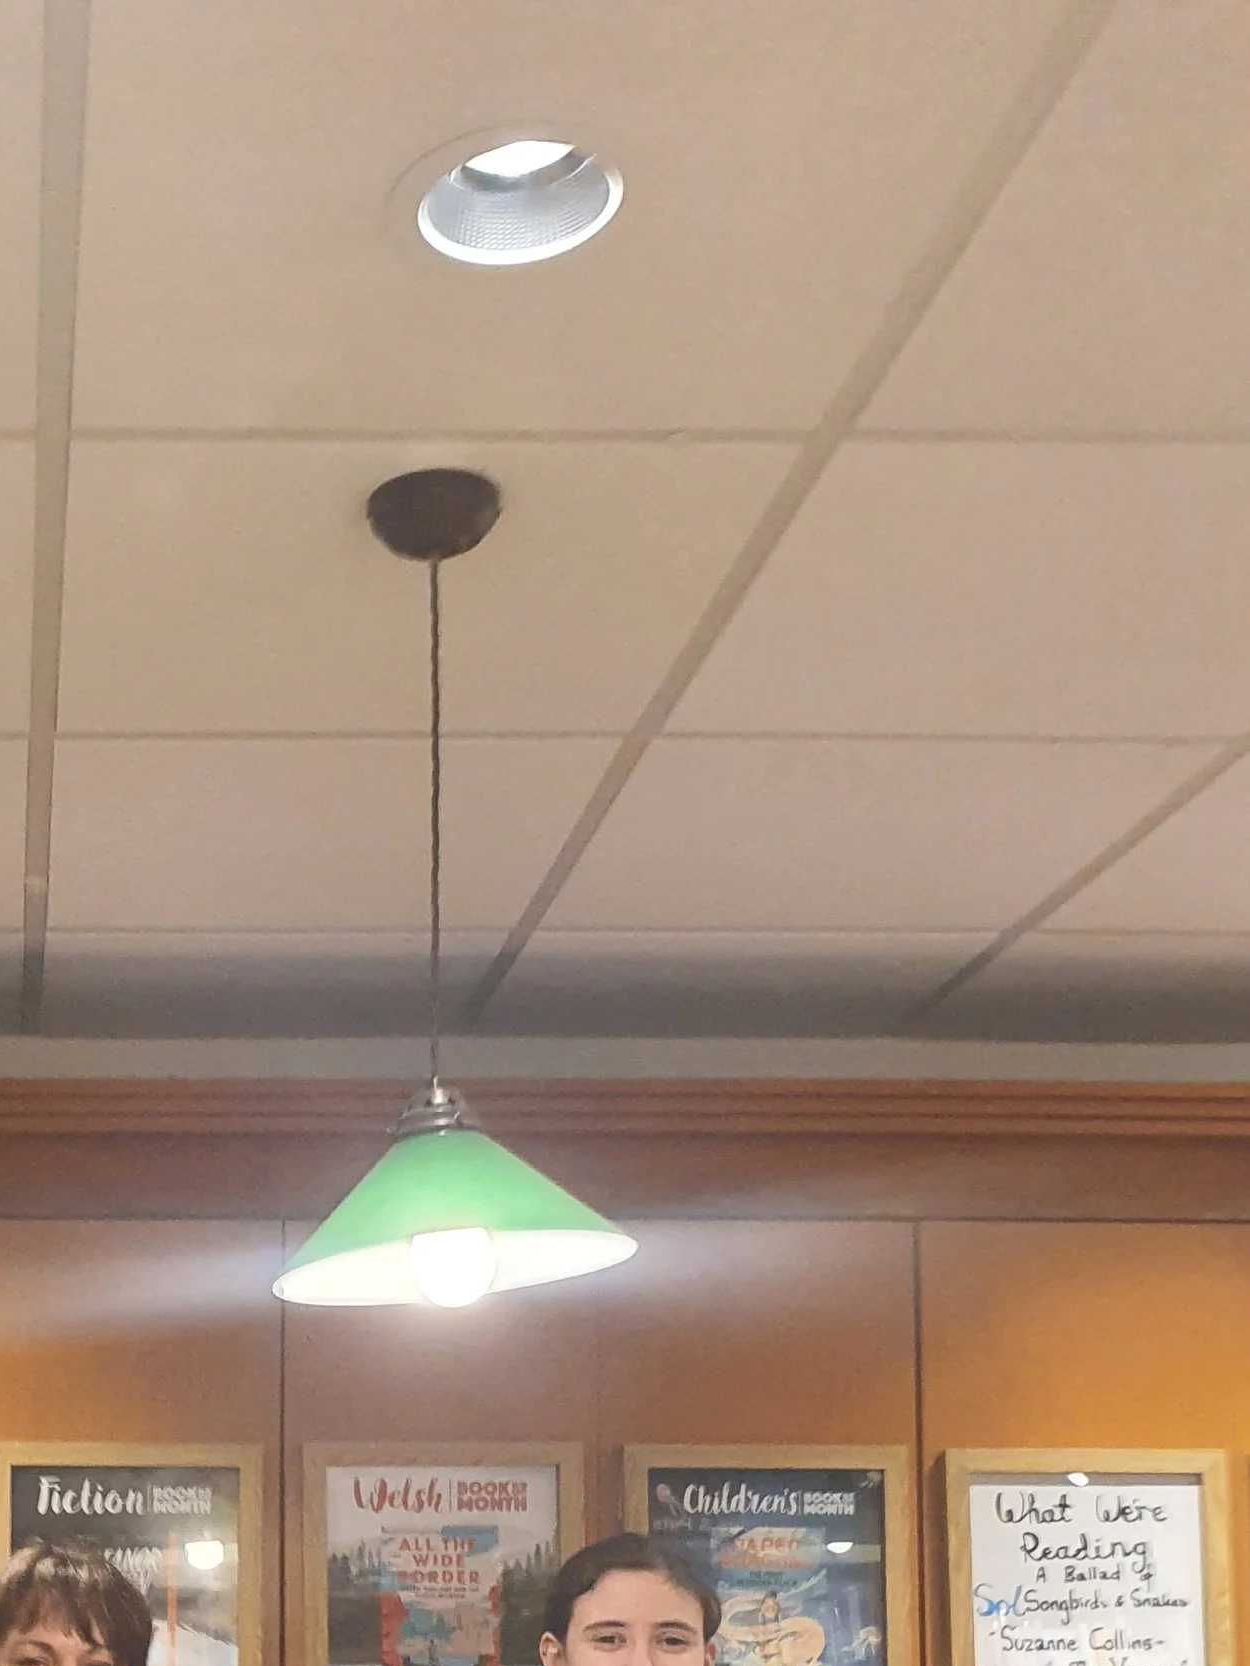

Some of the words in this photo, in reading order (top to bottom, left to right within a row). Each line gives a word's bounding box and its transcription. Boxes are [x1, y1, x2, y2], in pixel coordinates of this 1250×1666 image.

[38, 1475, 146, 1516] Fiction
[353, 1476, 443, 1514] Welsh
[457, 1481, 512, 1497] BOOK
[457, 1496, 528, 1512] MONTH
[683, 1481, 798, 1516] Children's
[995, 1491, 1073, 1524] What
[1095, 1493, 1169, 1523] We're
[803, 1502, 855, 1515] MONTH
[398, 1537, 434, 1551] ALL
[442, 1537, 476, 1551] THE
[1019, 1532, 1149, 1574] Reading
[412, 1554, 466, 1568] WIDE
[397, 1570, 481, 1585] BORDER
[1035, 1566, 1047, 1583] A
[1063, 1565, 1121, 1583] Ballad
[1022, 1588, 1109, 1626] Songbirds
[1129, 1588, 1190, 1609] Snakes
